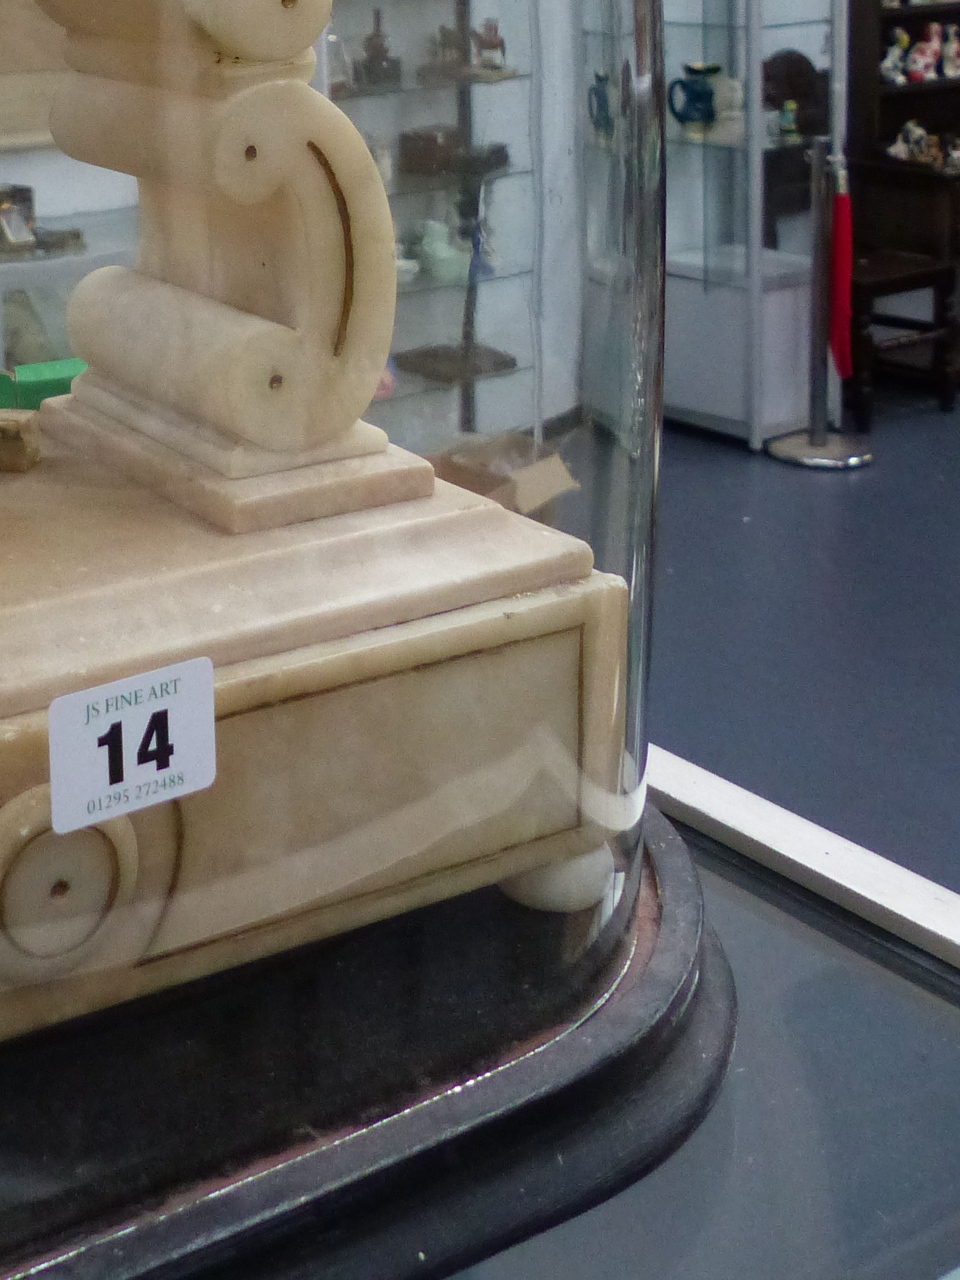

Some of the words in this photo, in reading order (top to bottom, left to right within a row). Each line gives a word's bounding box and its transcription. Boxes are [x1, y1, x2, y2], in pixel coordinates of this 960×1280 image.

[84, 702, 100, 725] JS
[105, 689, 143, 713] FINE
[148, 677, 181, 701] ART
[97, 708, 174, 786] 14
[87, 787, 130, 815] 01295
[135, 771, 185, 800] 272488
